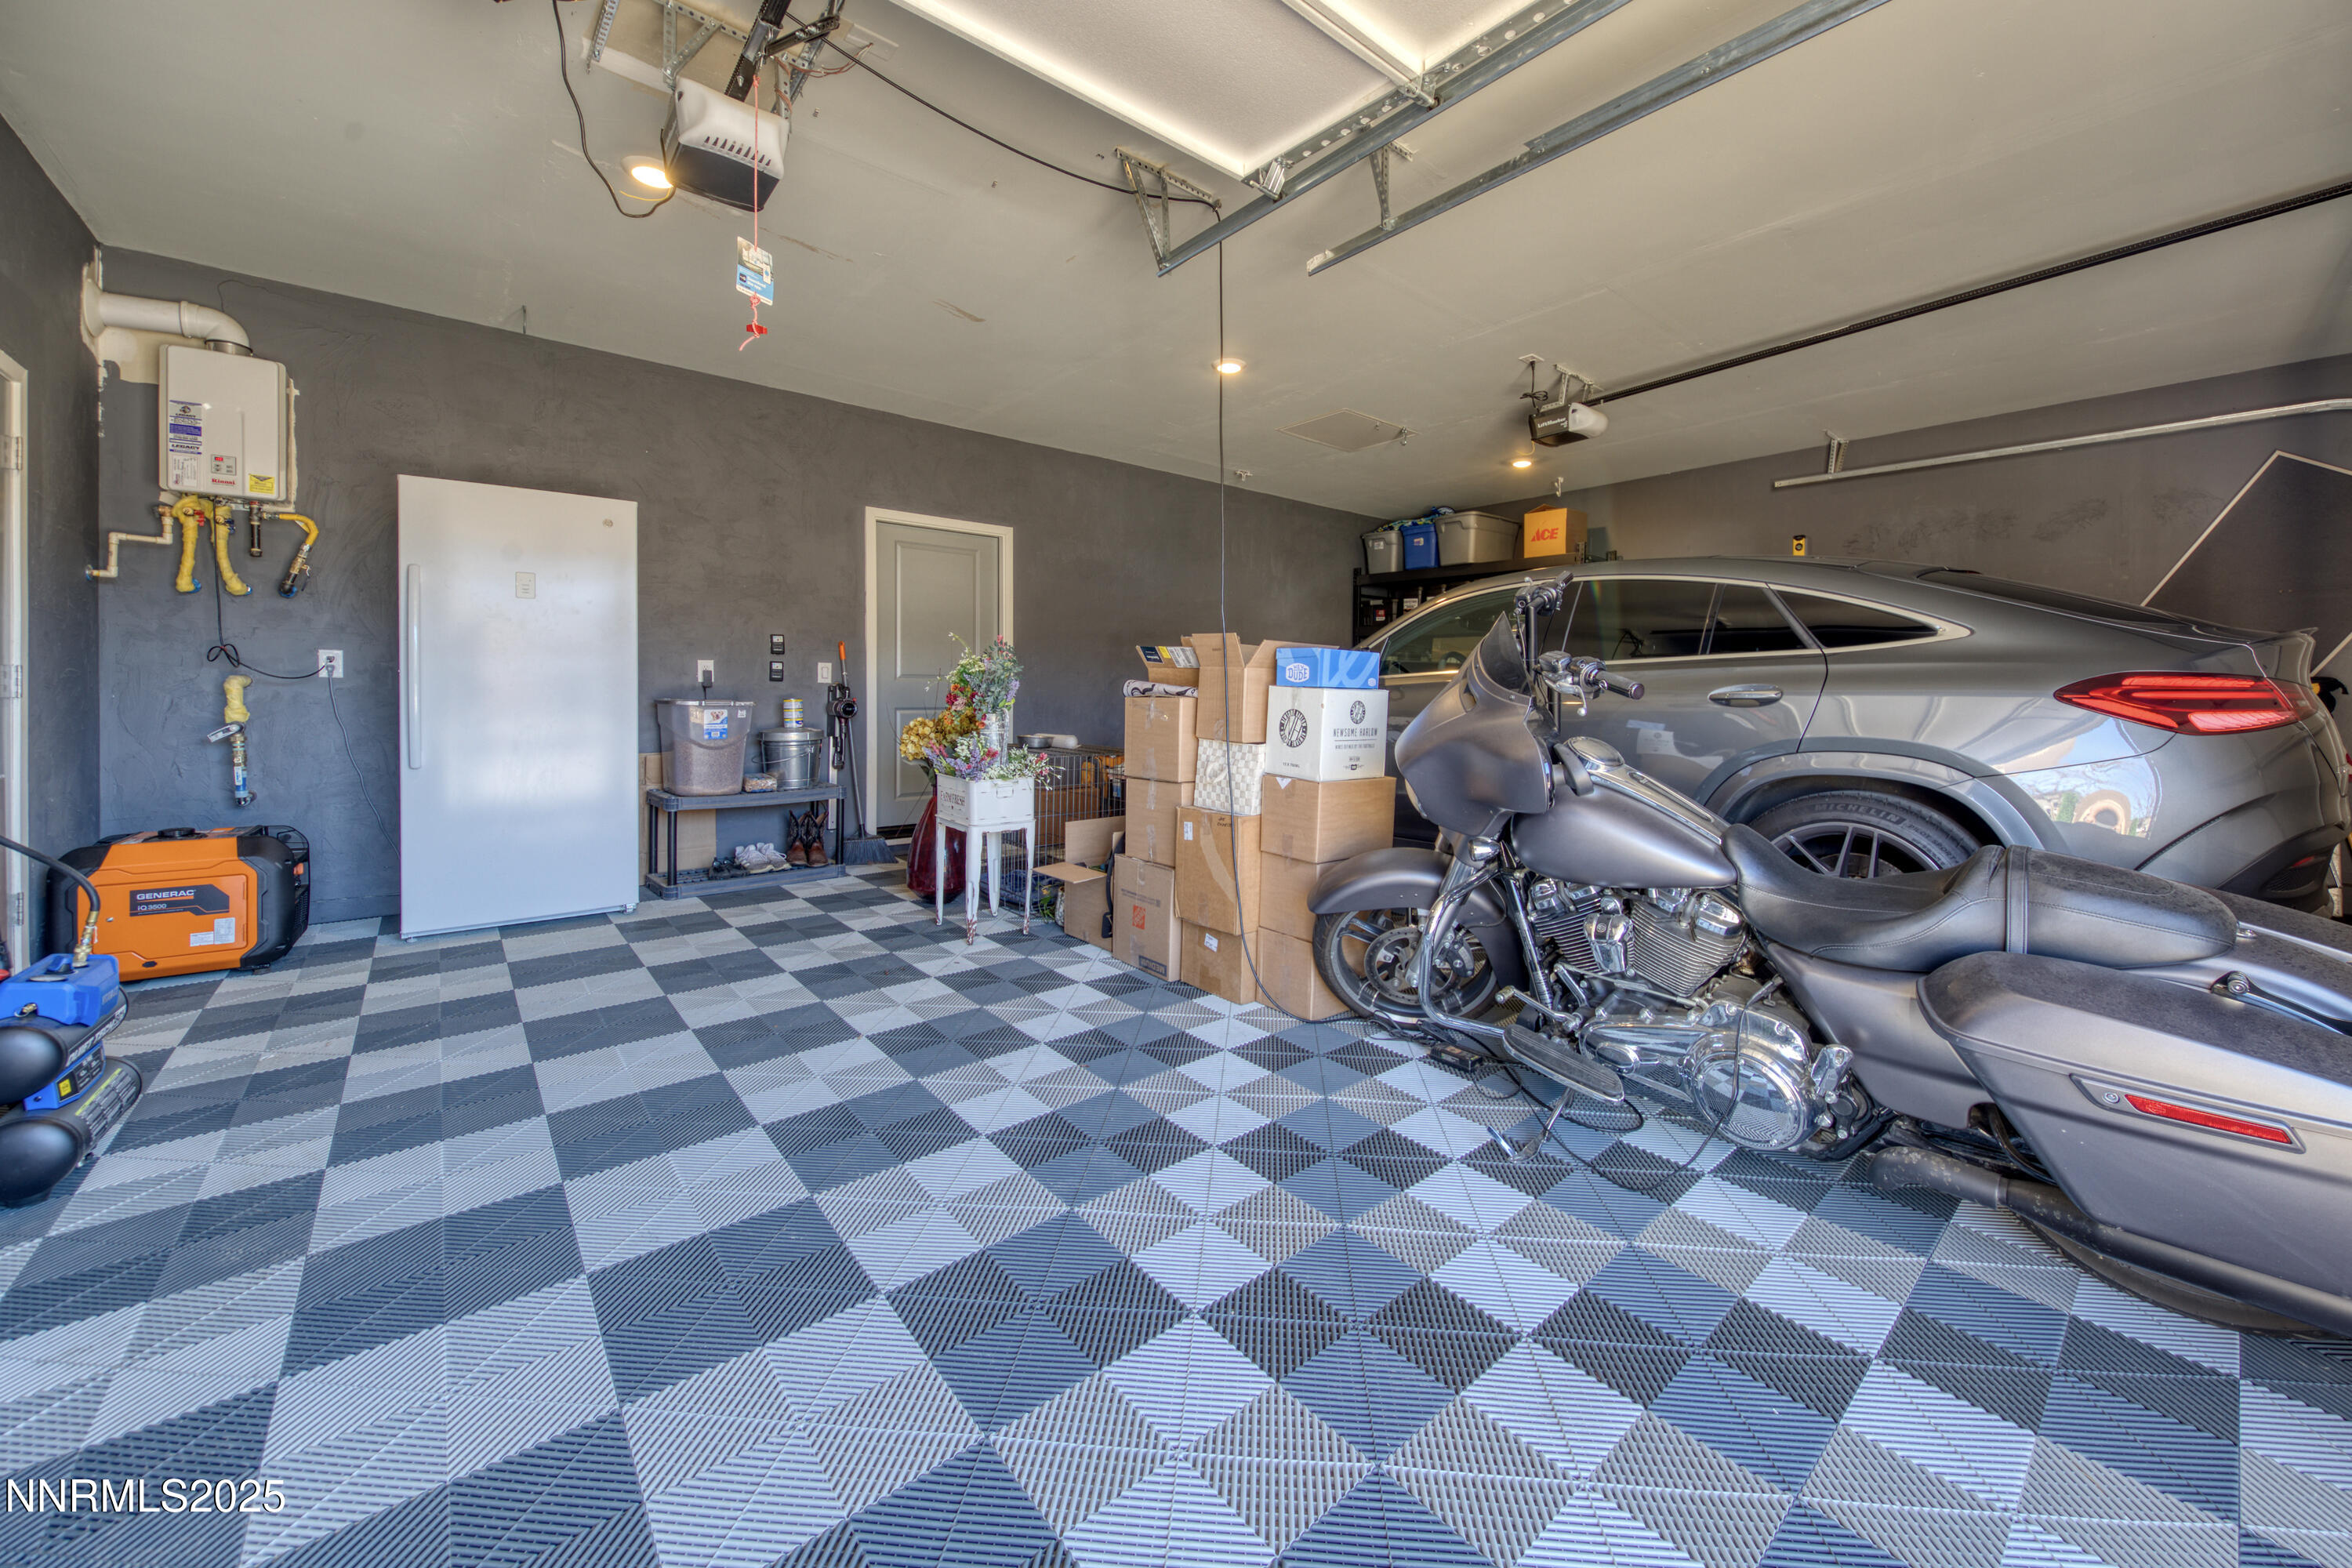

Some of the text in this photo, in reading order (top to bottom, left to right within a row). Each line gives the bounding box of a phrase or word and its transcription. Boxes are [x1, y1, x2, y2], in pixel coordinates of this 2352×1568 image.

[1537, 418, 1566, 428] LiftMaster
[1531, 528, 1559, 542] ACE
[1287, 668, 1308, 681] DUDE
[1333, 728, 1378, 737] NEWSOME HARLOW
[940, 790, 966, 807] FARM FRESH
[1815, 804, 1900, 822] MICHELIN
[1908, 824, 1932, 839] PILOT
[1931, 840, 1957, 859] SPORT
[136, 890, 194, 900] GENERAC
[65, 1036, 95, 1067] QUIET
